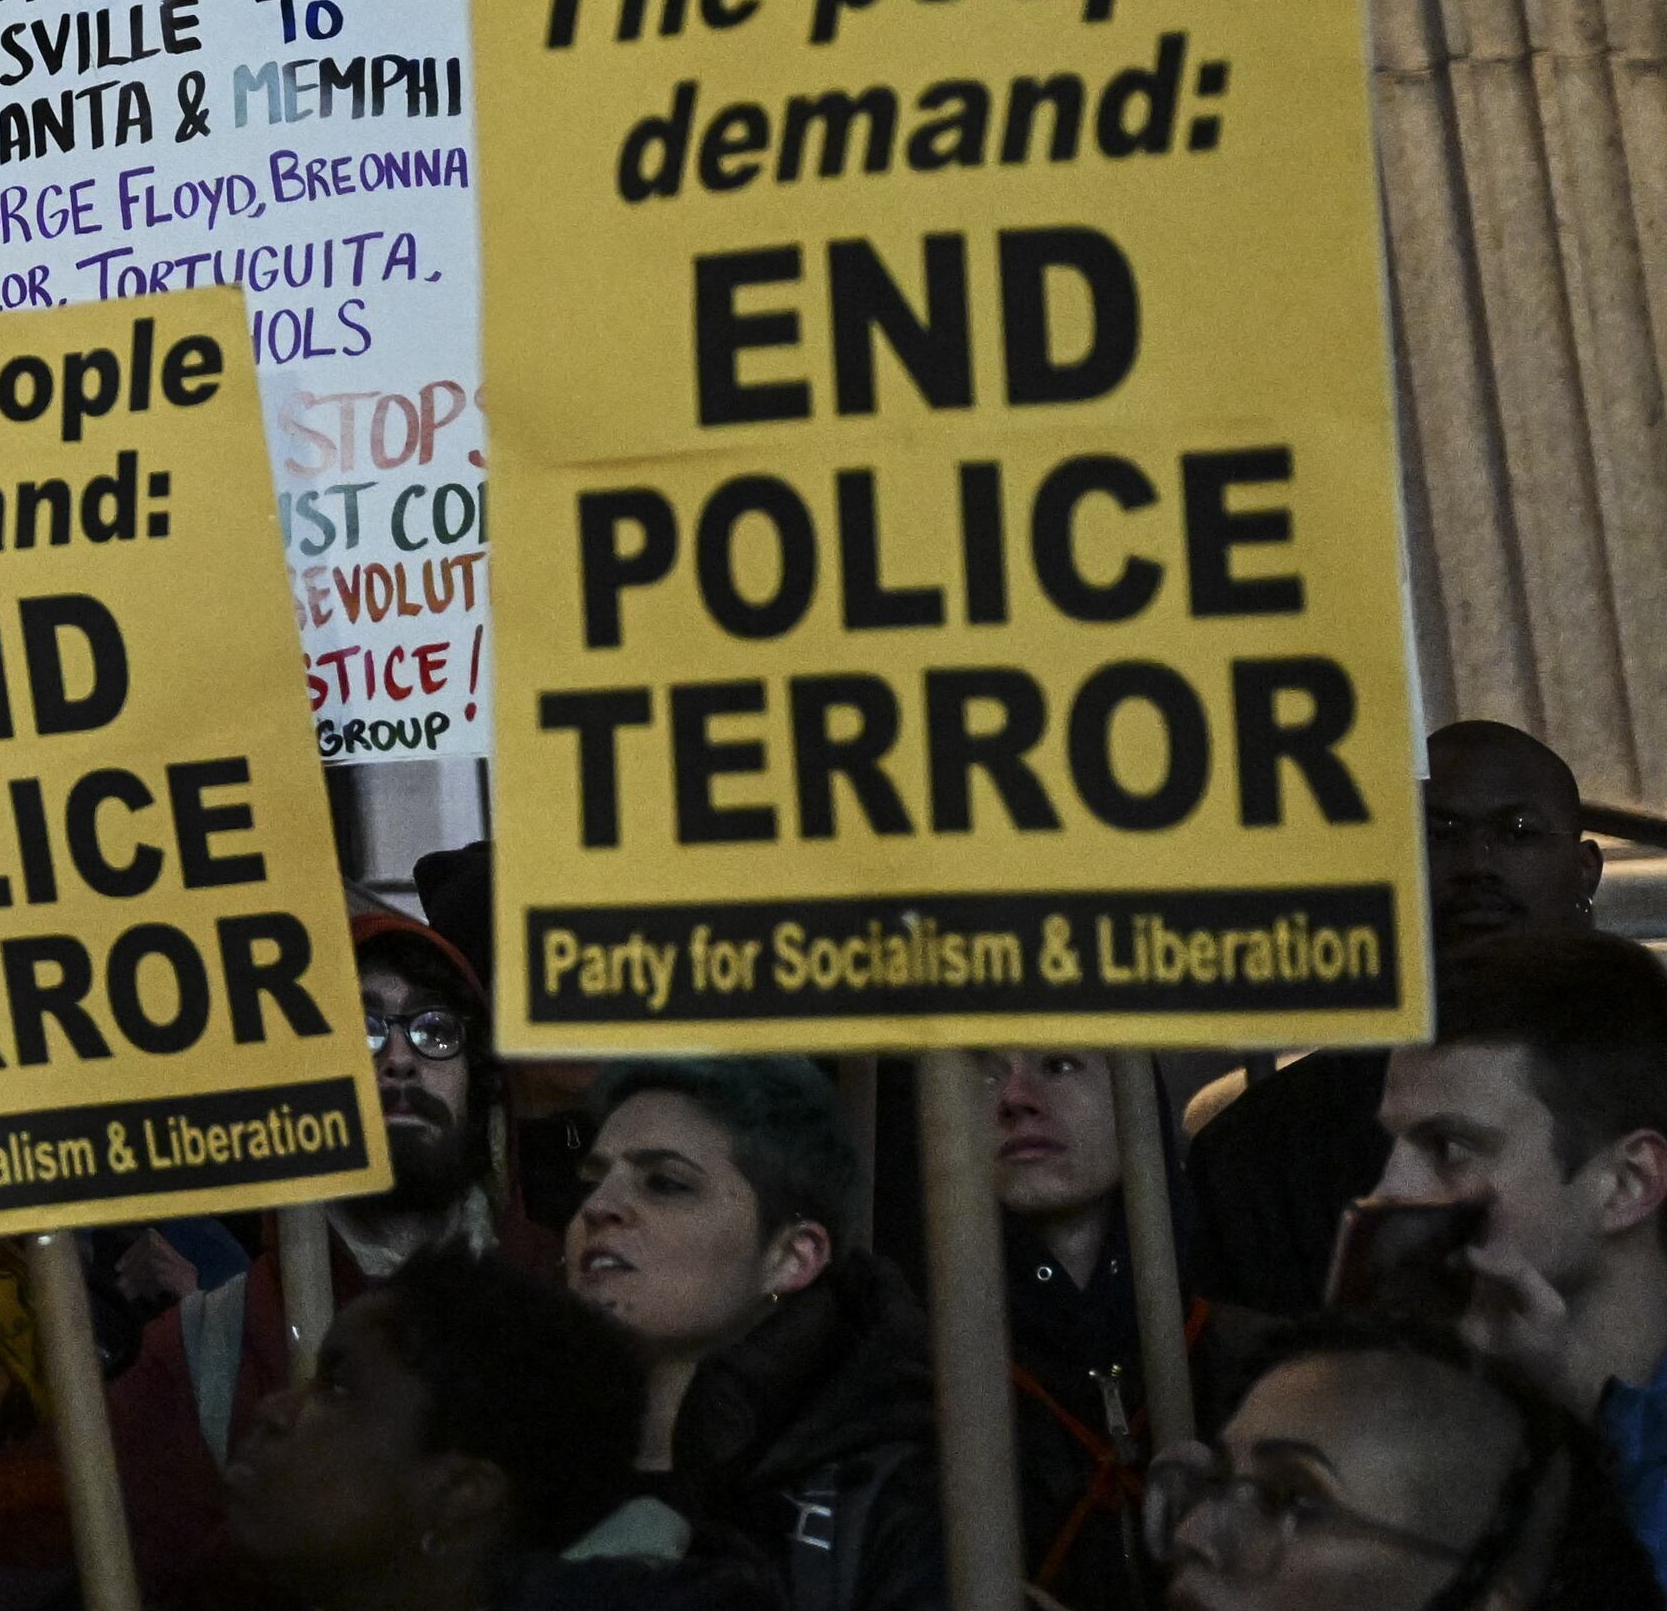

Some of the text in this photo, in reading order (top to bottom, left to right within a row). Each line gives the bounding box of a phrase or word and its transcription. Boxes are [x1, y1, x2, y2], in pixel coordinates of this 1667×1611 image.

[174, 70, 212, 143] &
[233, 58, 461, 129] MEMPHI
[616, 31, 1231, 204] demand:
[268, 148, 468, 206] BREONNA
[693, 225, 1142, 430] END
[577, 444, 1307, 650] POLICE
[538, 654, 1372, 850] TERROR
[543, 910, 1379, 1010] Party for Socialism & Liberation
[107, 1121, 136, 1172] &
[144, 1101, 348, 1171] Liberation
